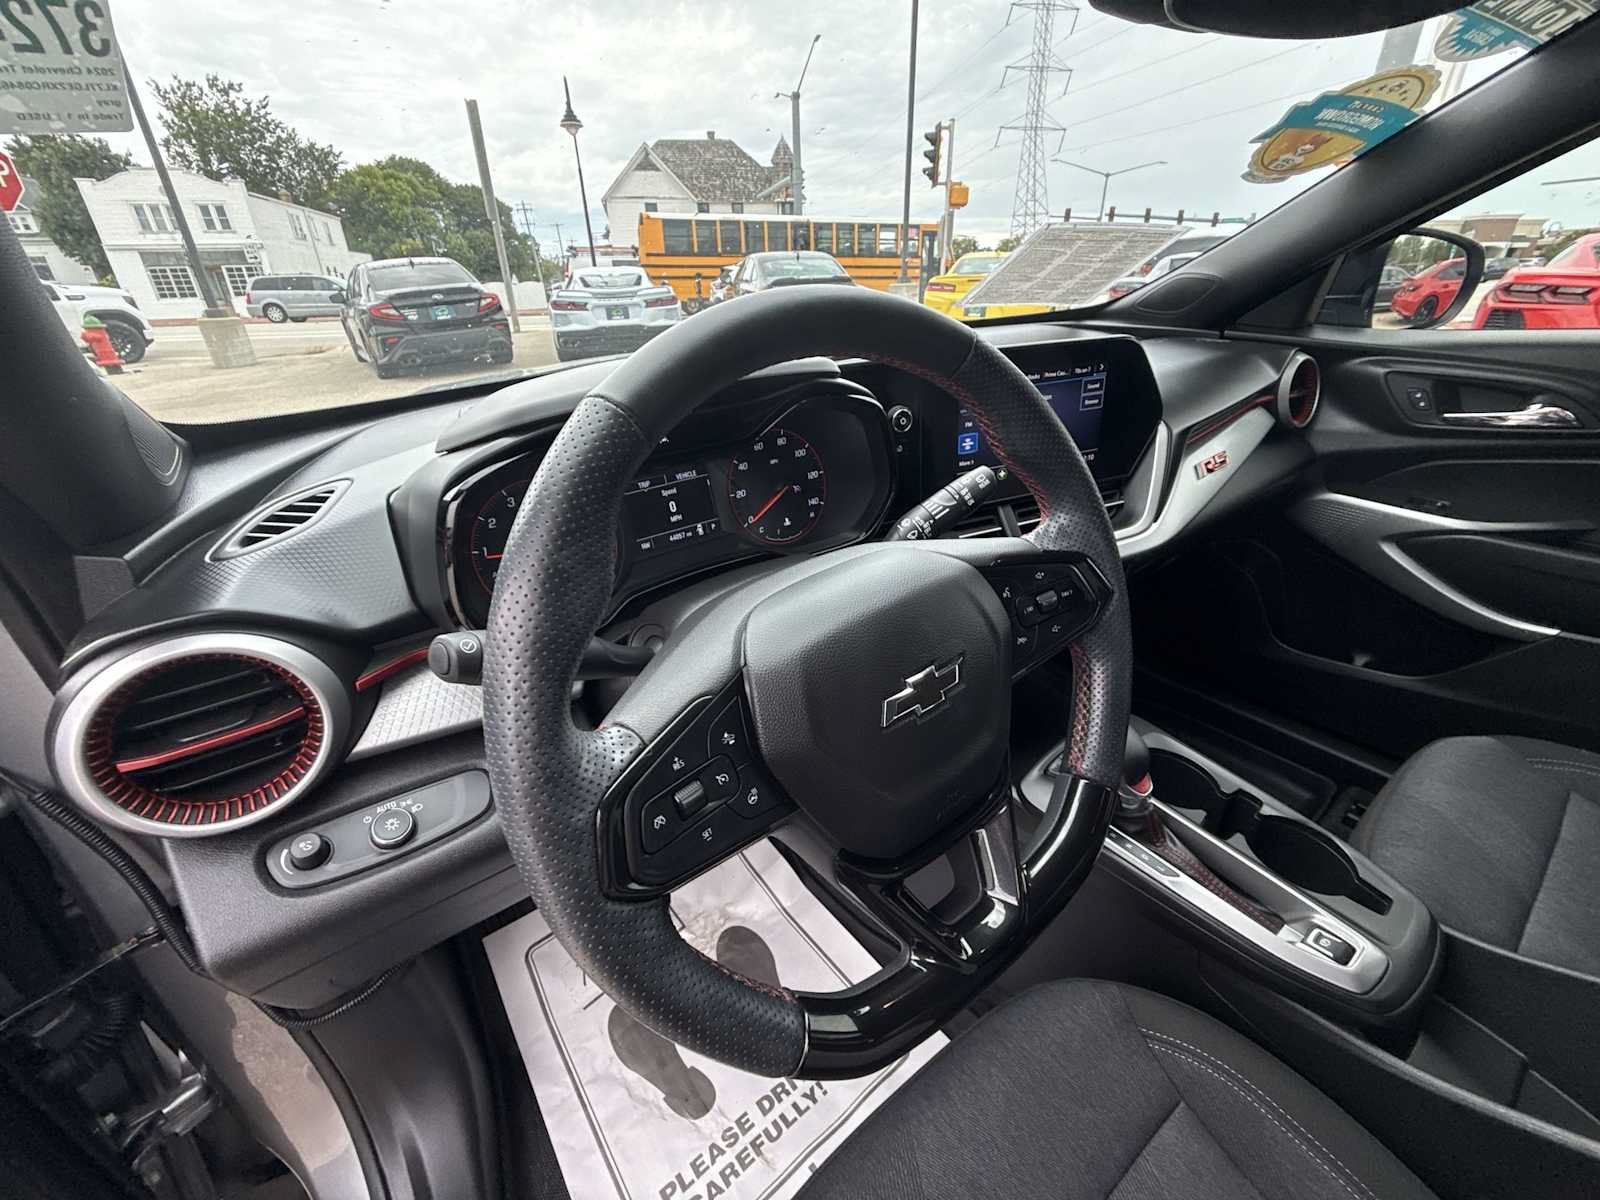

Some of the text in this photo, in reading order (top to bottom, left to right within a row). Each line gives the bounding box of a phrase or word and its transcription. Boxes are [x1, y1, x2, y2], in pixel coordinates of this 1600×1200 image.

[753, 442, 764, 451] 60
[776, 437, 787, 446] 80
[794, 448, 807, 457] 100
[738, 462, 748, 470] 40
[1196, 450, 1231, 480] RS
[807, 470, 819, 480] 120
[736, 489, 747, 498] 20
[506, 497, 515, 508] 3
[668, 500, 677, 513] 0
[808, 497, 820, 506] 140
[487, 518, 497, 529] 2
[376, 801, 397, 814] AUTO
[658, 1077, 806, 1200] PLEASE DRI
